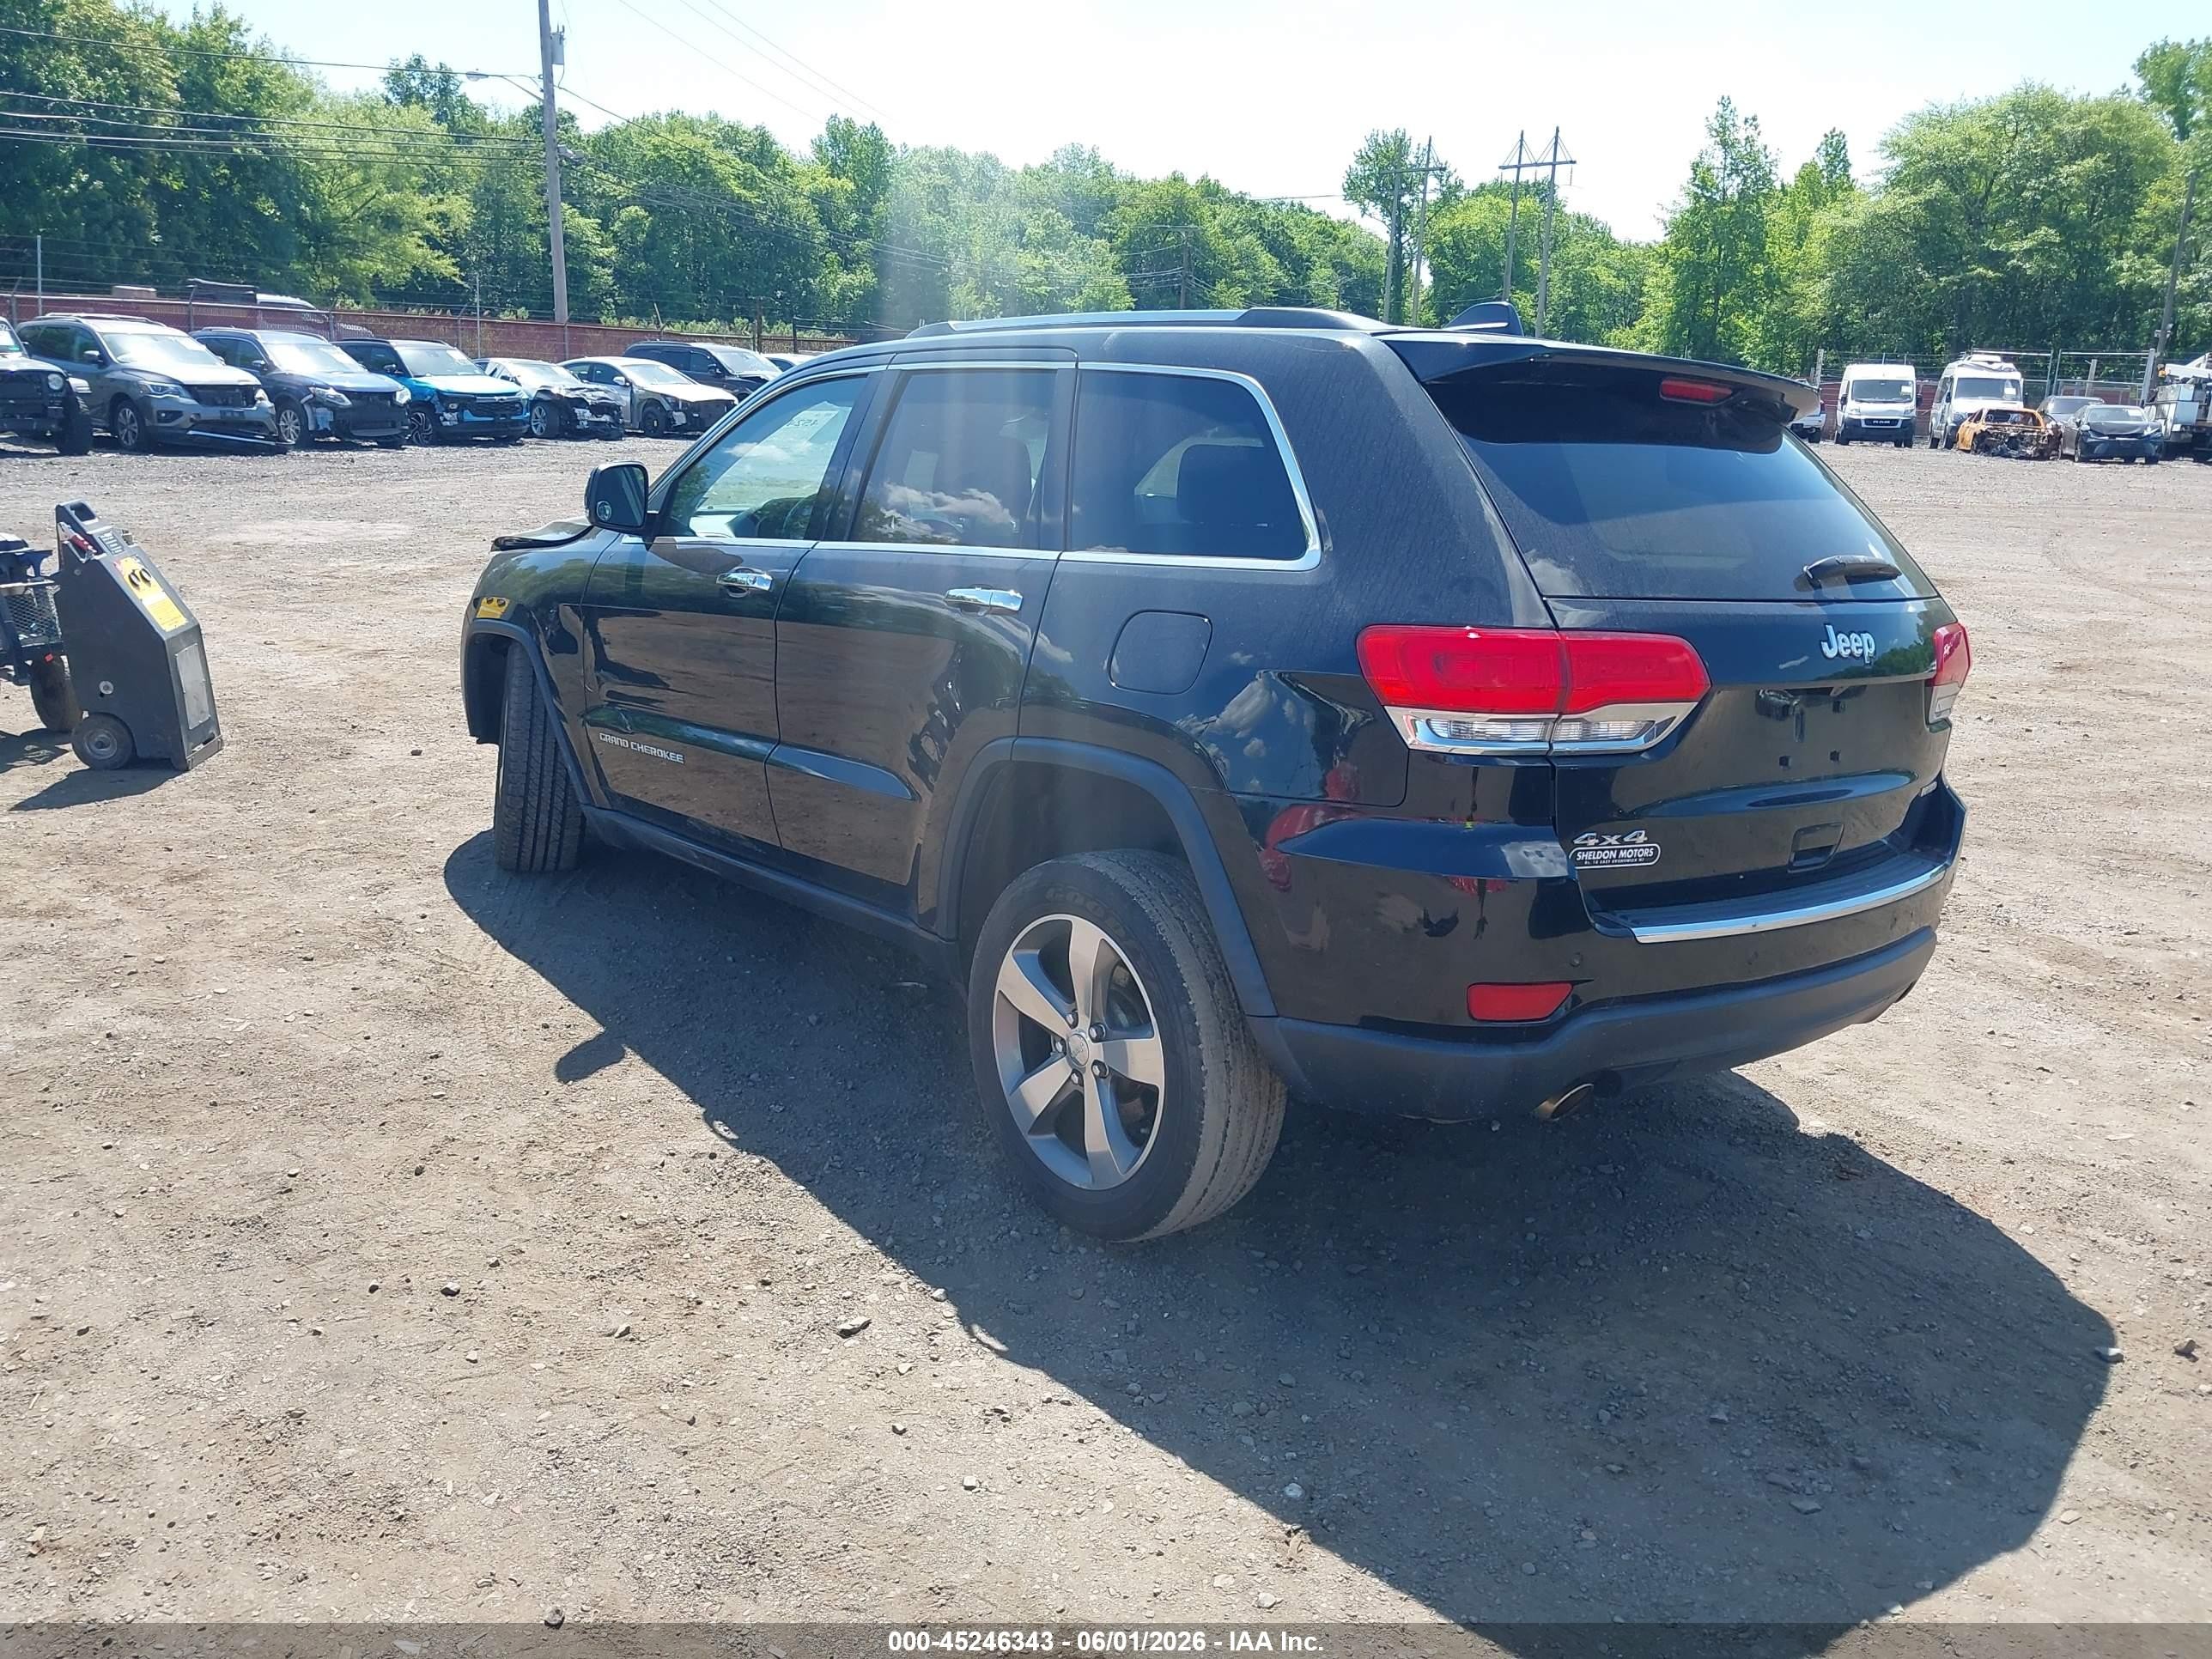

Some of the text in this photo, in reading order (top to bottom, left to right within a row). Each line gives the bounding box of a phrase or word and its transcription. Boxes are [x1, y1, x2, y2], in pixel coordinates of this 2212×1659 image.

[1821, 624, 1875, 665] Jeep
[599, 732, 684, 763] GRAND CHEROKEE
[1573, 830, 1648, 846] 4x4
[1576, 848, 1654, 860] SHELDON MOTORS
